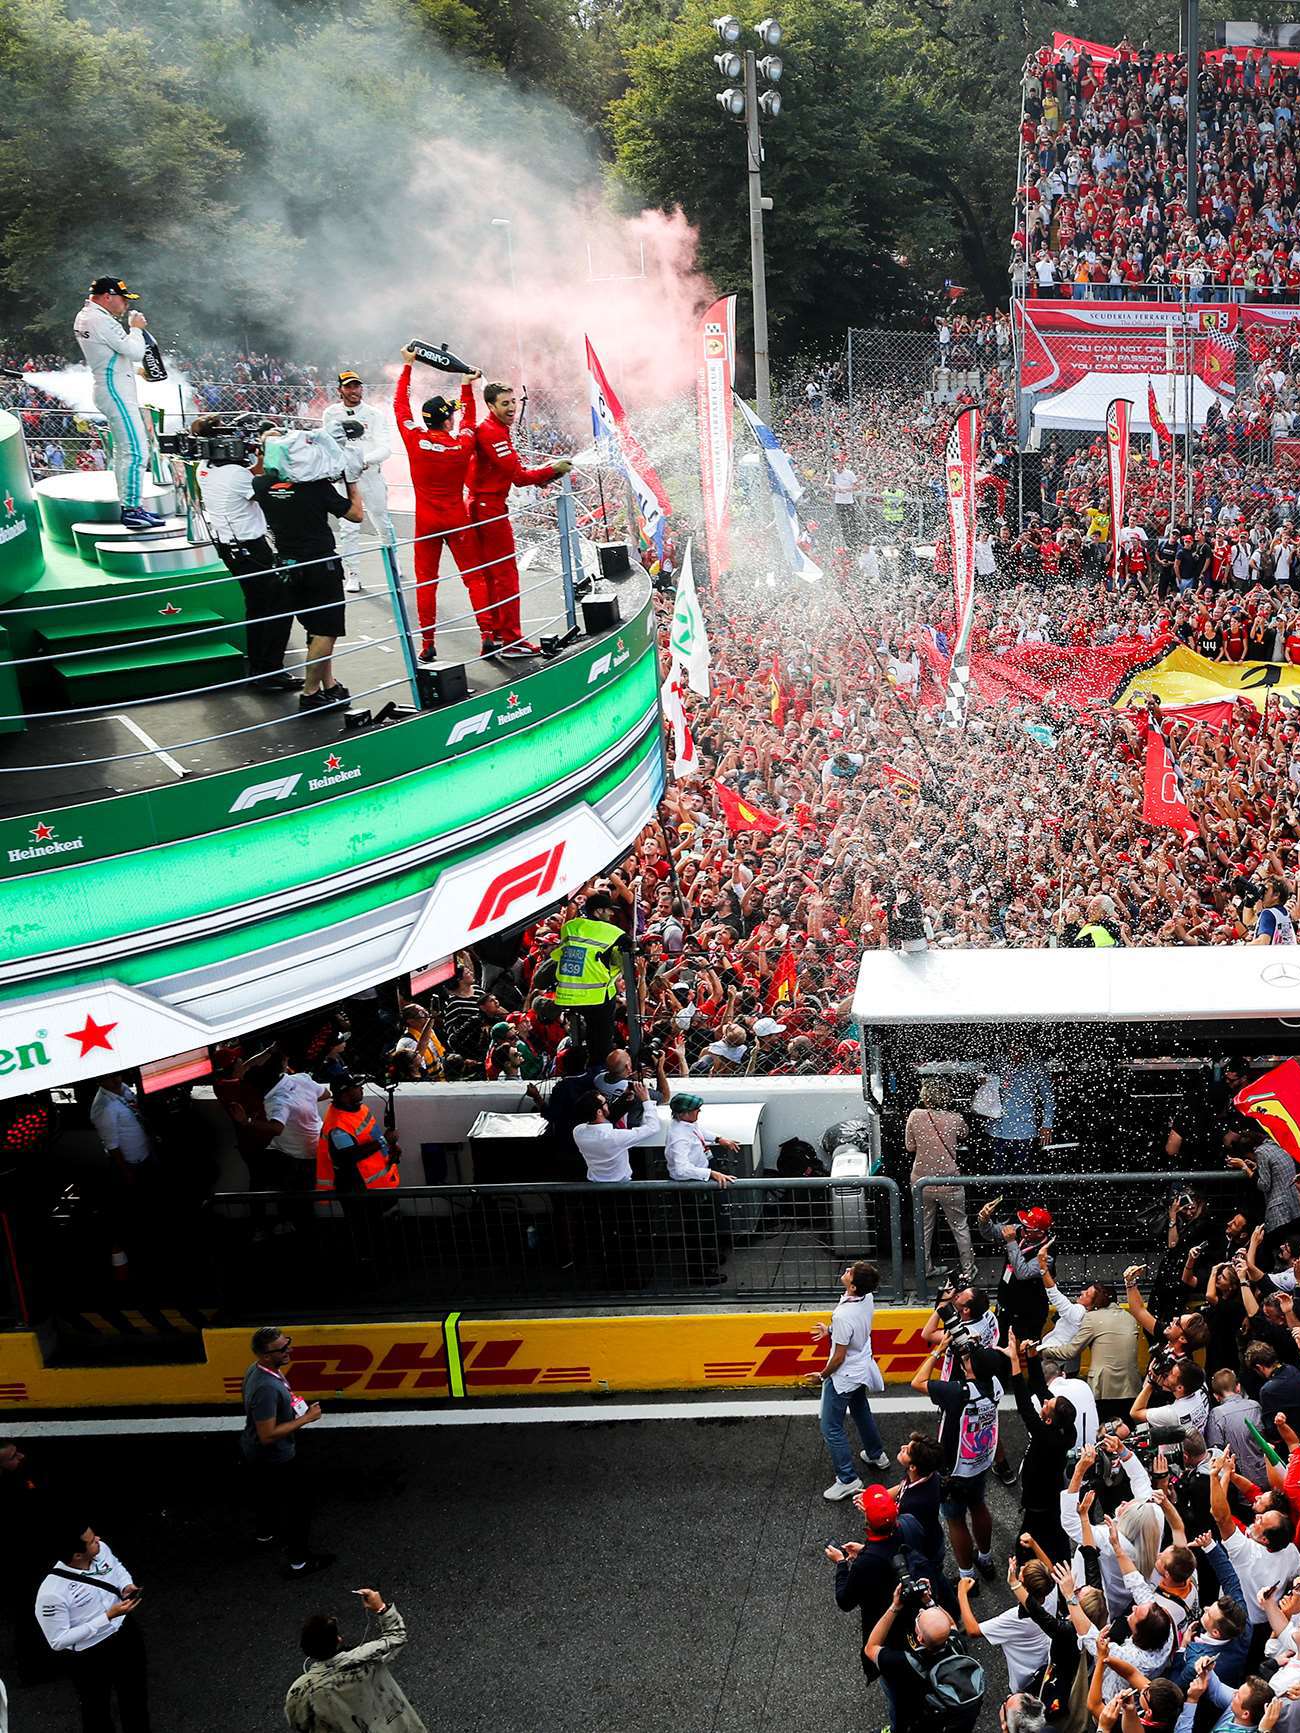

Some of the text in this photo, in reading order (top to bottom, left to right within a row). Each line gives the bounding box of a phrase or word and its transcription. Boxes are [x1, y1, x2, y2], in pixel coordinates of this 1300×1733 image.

[1094, 345, 1117, 353] CAN
[1120, 345, 1142, 353] NOT
[1202, 640, 1217, 652] 44
[587, 652, 613, 684] F1
[446, 704, 533, 747] F1 Heineken
[228, 766, 361, 814] F1 Heineken
[8, 837, 83, 863] Heineken
[467, 840, 567, 932] F1
[288, 1339, 542, 1392] DHL
[753, 1328, 960, 1377] DH
